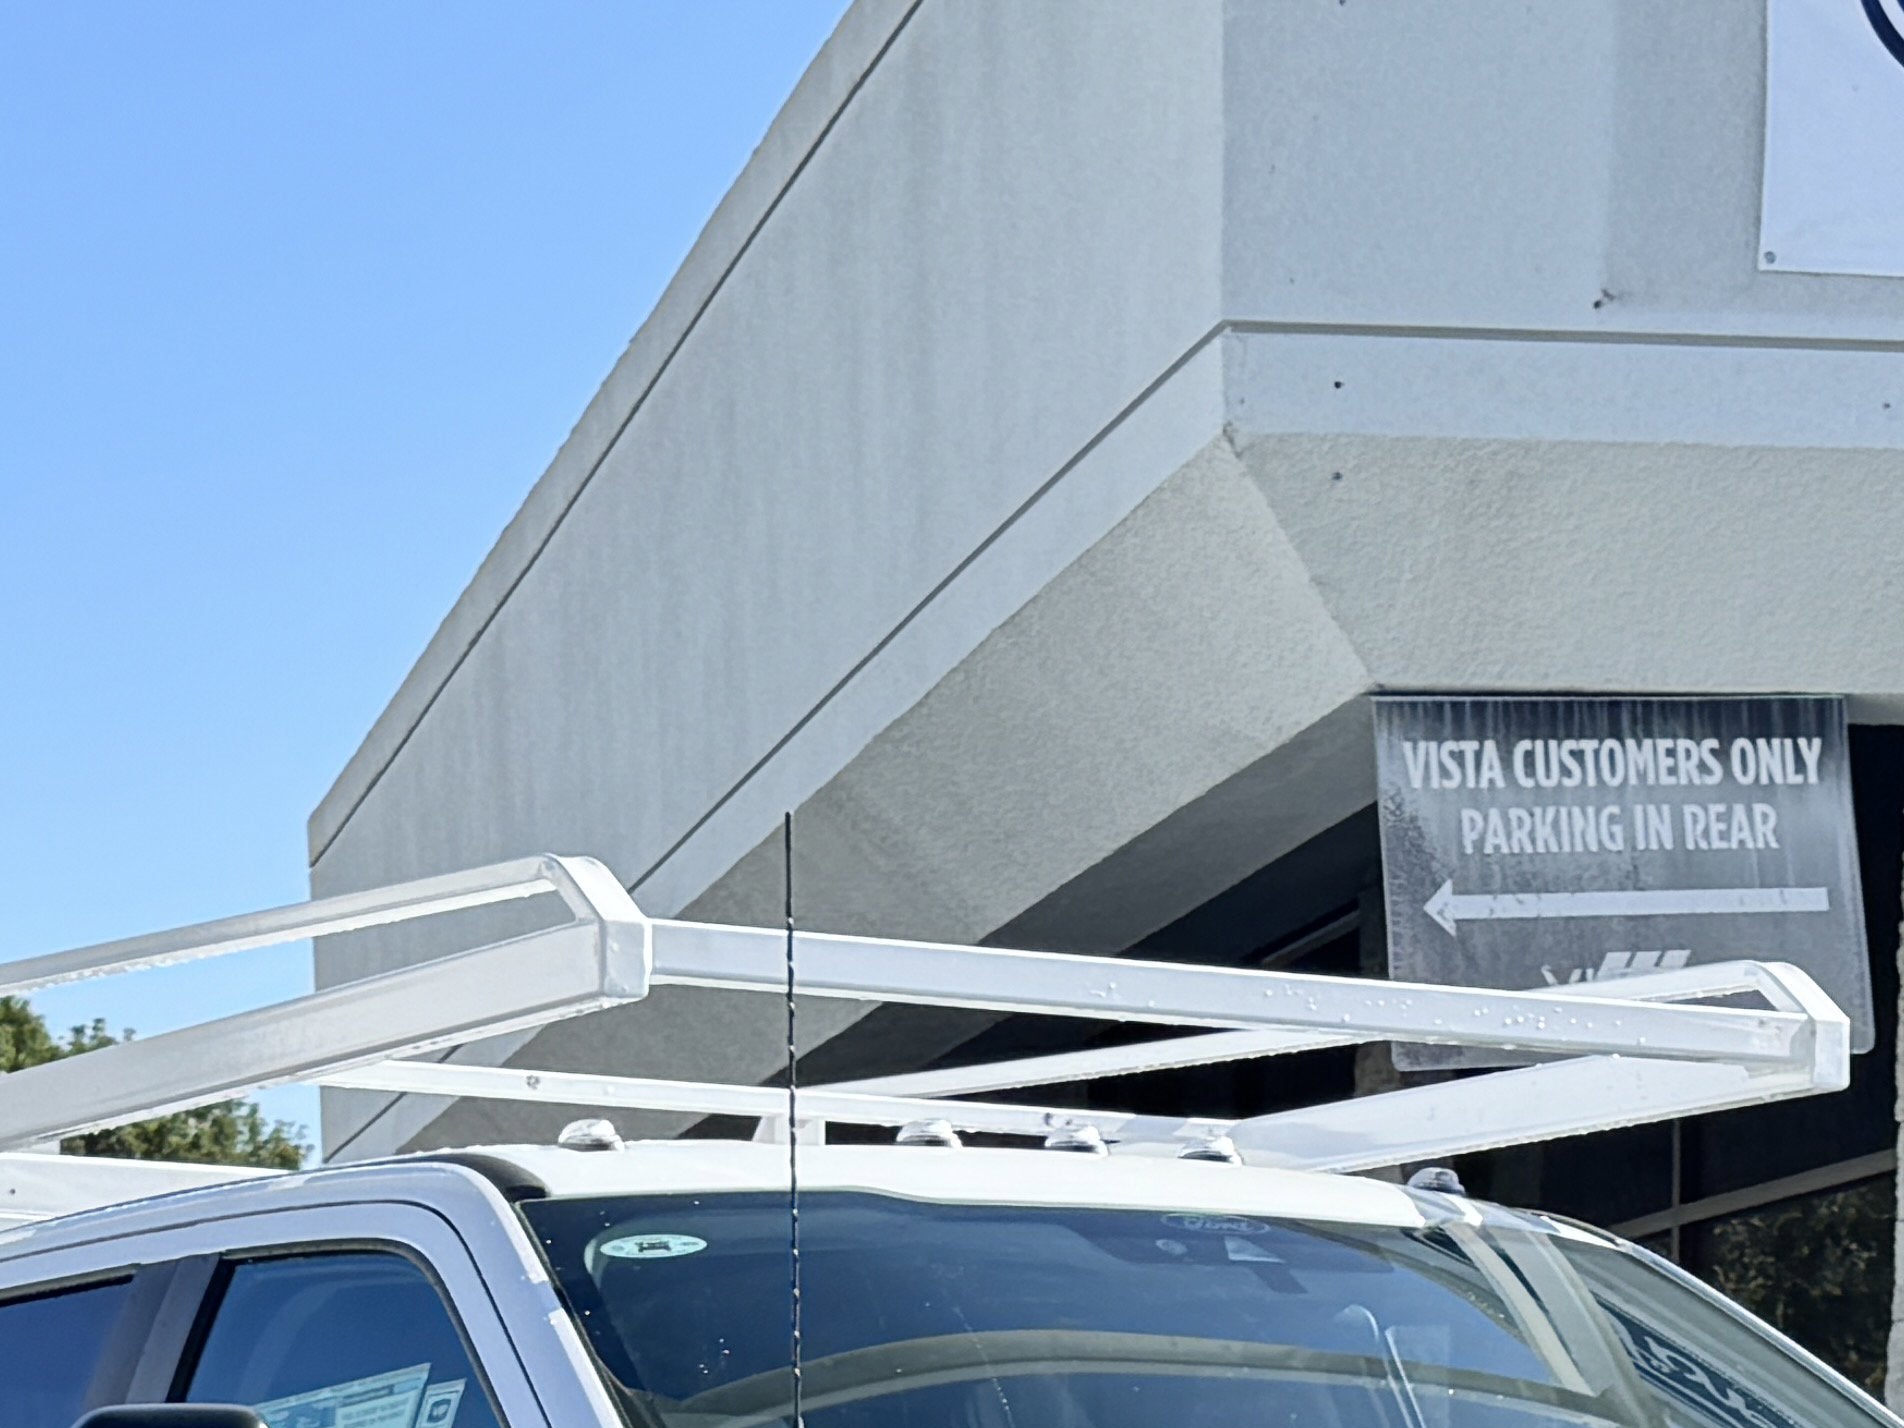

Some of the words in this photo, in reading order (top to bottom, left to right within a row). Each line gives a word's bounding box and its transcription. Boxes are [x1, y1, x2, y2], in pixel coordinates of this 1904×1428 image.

[1402, 740, 1505, 789] VISTA
[1512, 737, 1724, 788] CUSTOMERS
[1730, 737, 1823, 786] ONLY
[1460, 806, 1624, 854] PARKING
[1635, 806, 1674, 850] IN
[1684, 803, 1781, 850] REAR
